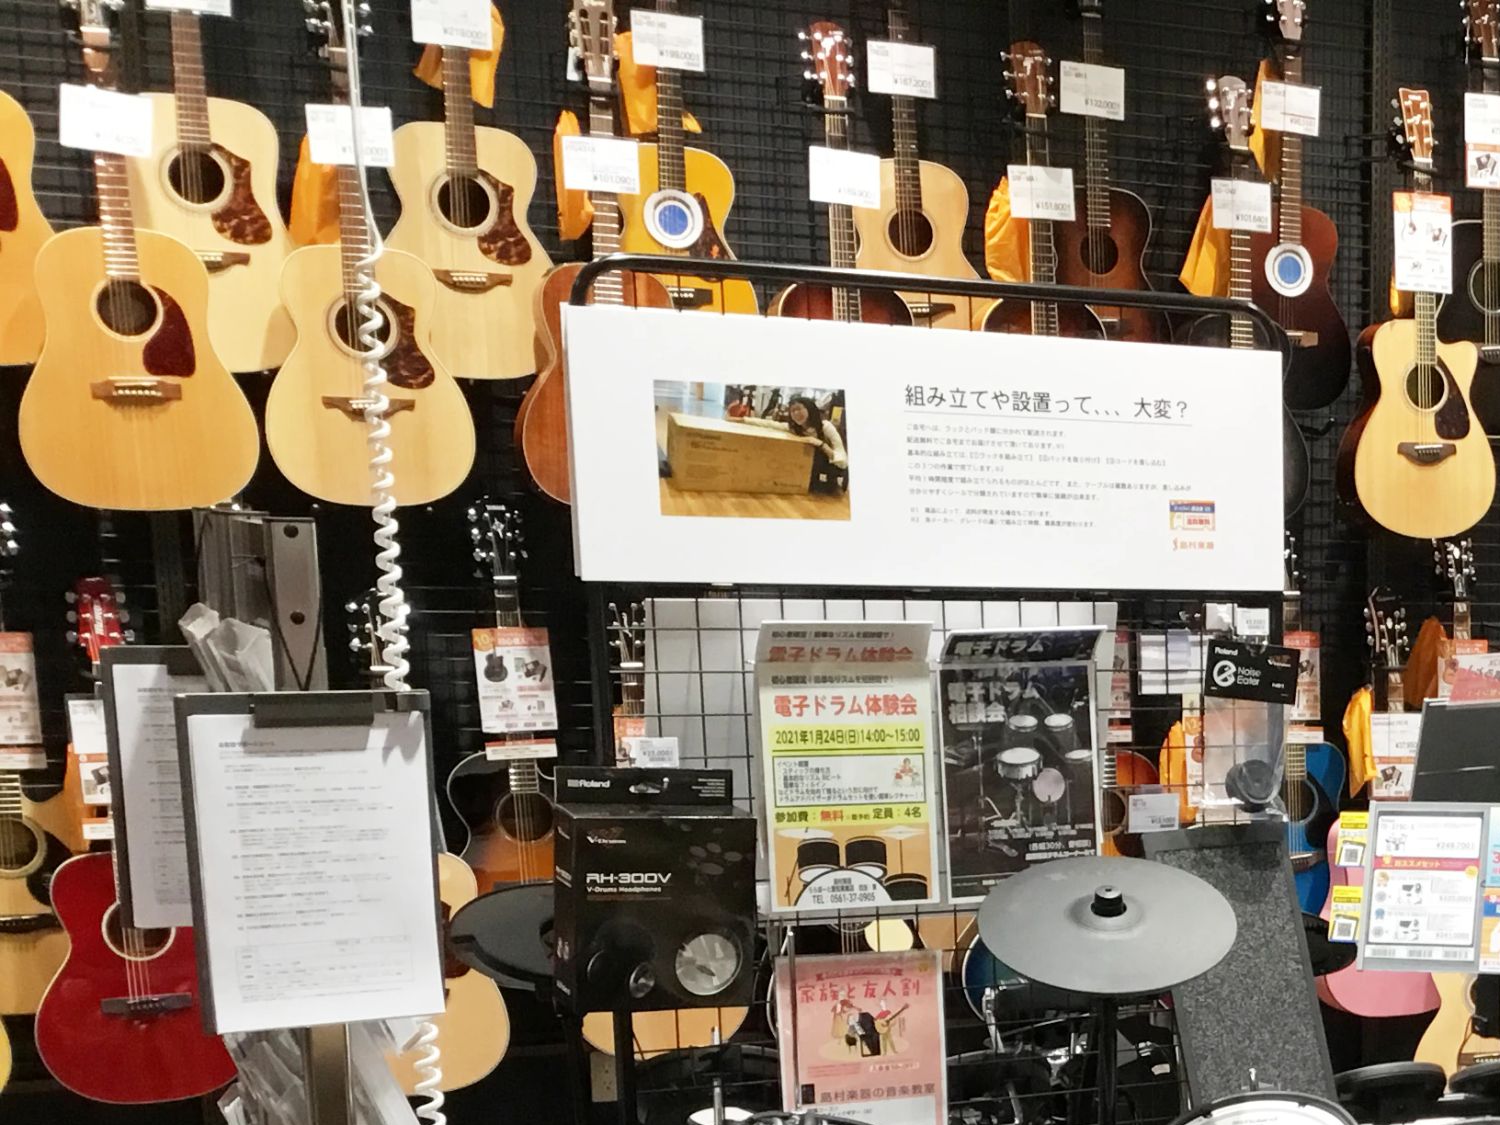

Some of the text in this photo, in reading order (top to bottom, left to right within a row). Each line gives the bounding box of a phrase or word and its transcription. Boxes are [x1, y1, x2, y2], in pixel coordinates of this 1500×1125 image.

[1237, 666, 1262, 677] Noise
[1236, 675, 1260, 686] Eater
[774, 694, 918, 717] 電子ドラム体験会
[579, 779, 611, 789] Roland
[586, 872, 672, 885] RH-300V
[798, 979, 921, 1004] 家族と友人割
